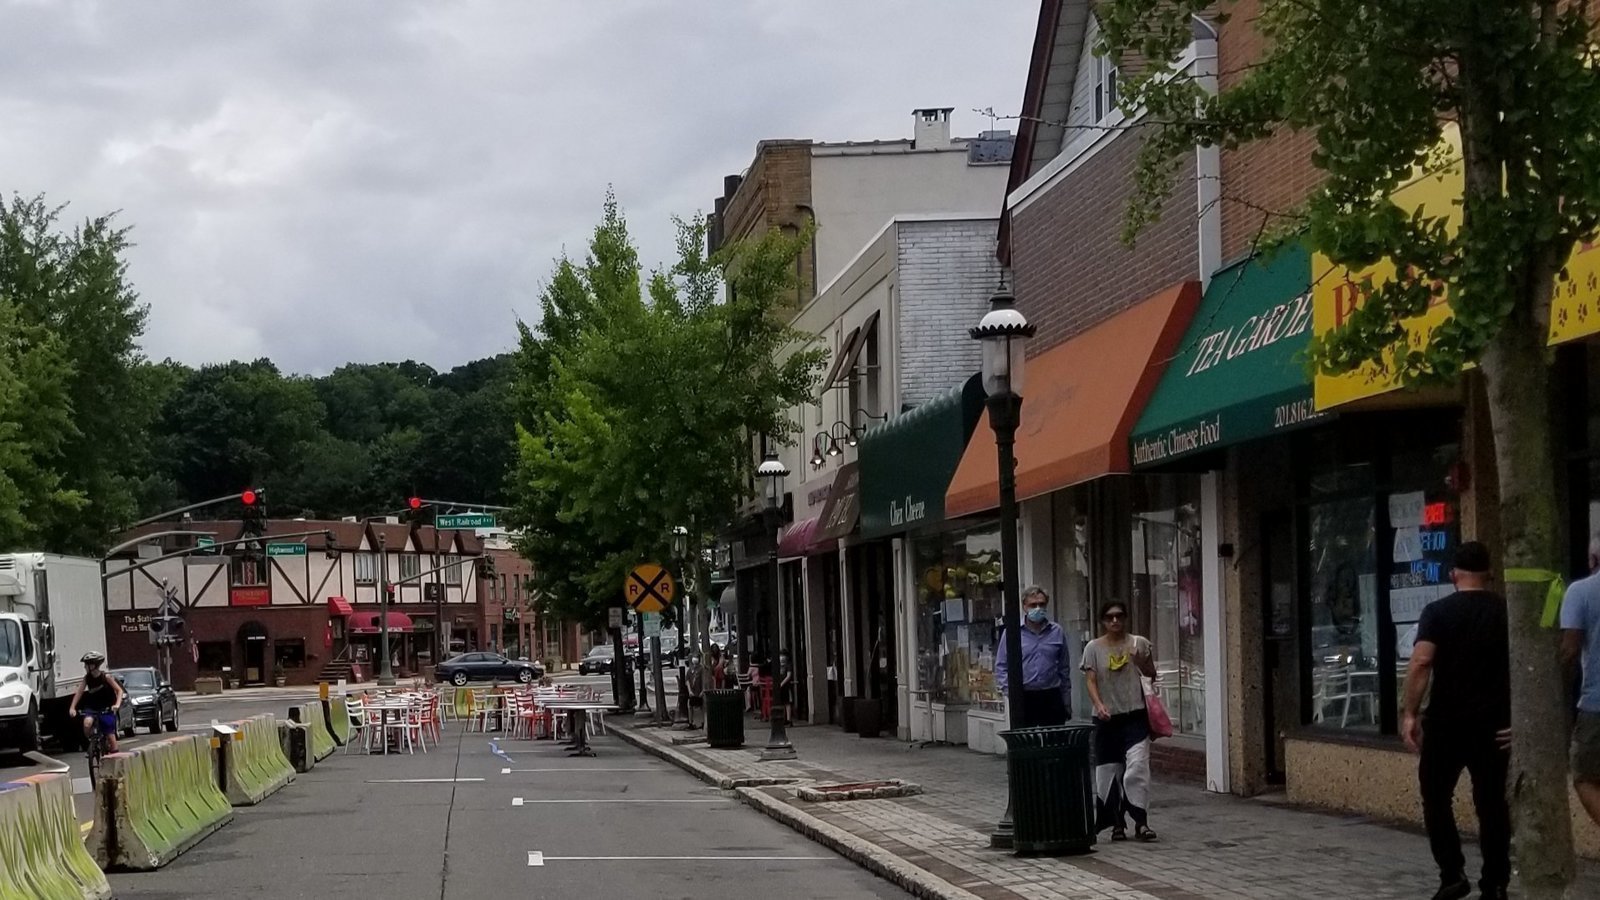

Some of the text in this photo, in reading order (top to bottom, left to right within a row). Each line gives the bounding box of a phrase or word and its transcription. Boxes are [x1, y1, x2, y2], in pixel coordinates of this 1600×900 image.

[1185, 325, 1234, 377] TEA
[1226, 292, 1314, 360] GARDE
[1274, 397, 1328, 428] 201.816.2
[1133, 413, 1220, 466] Authentic Chinese Food
[439, 518, 455, 526] West
[457, 517, 481, 526] Railroad
[629, 583, 670, 595] R R
[124, 614, 152, 623] The Stati
